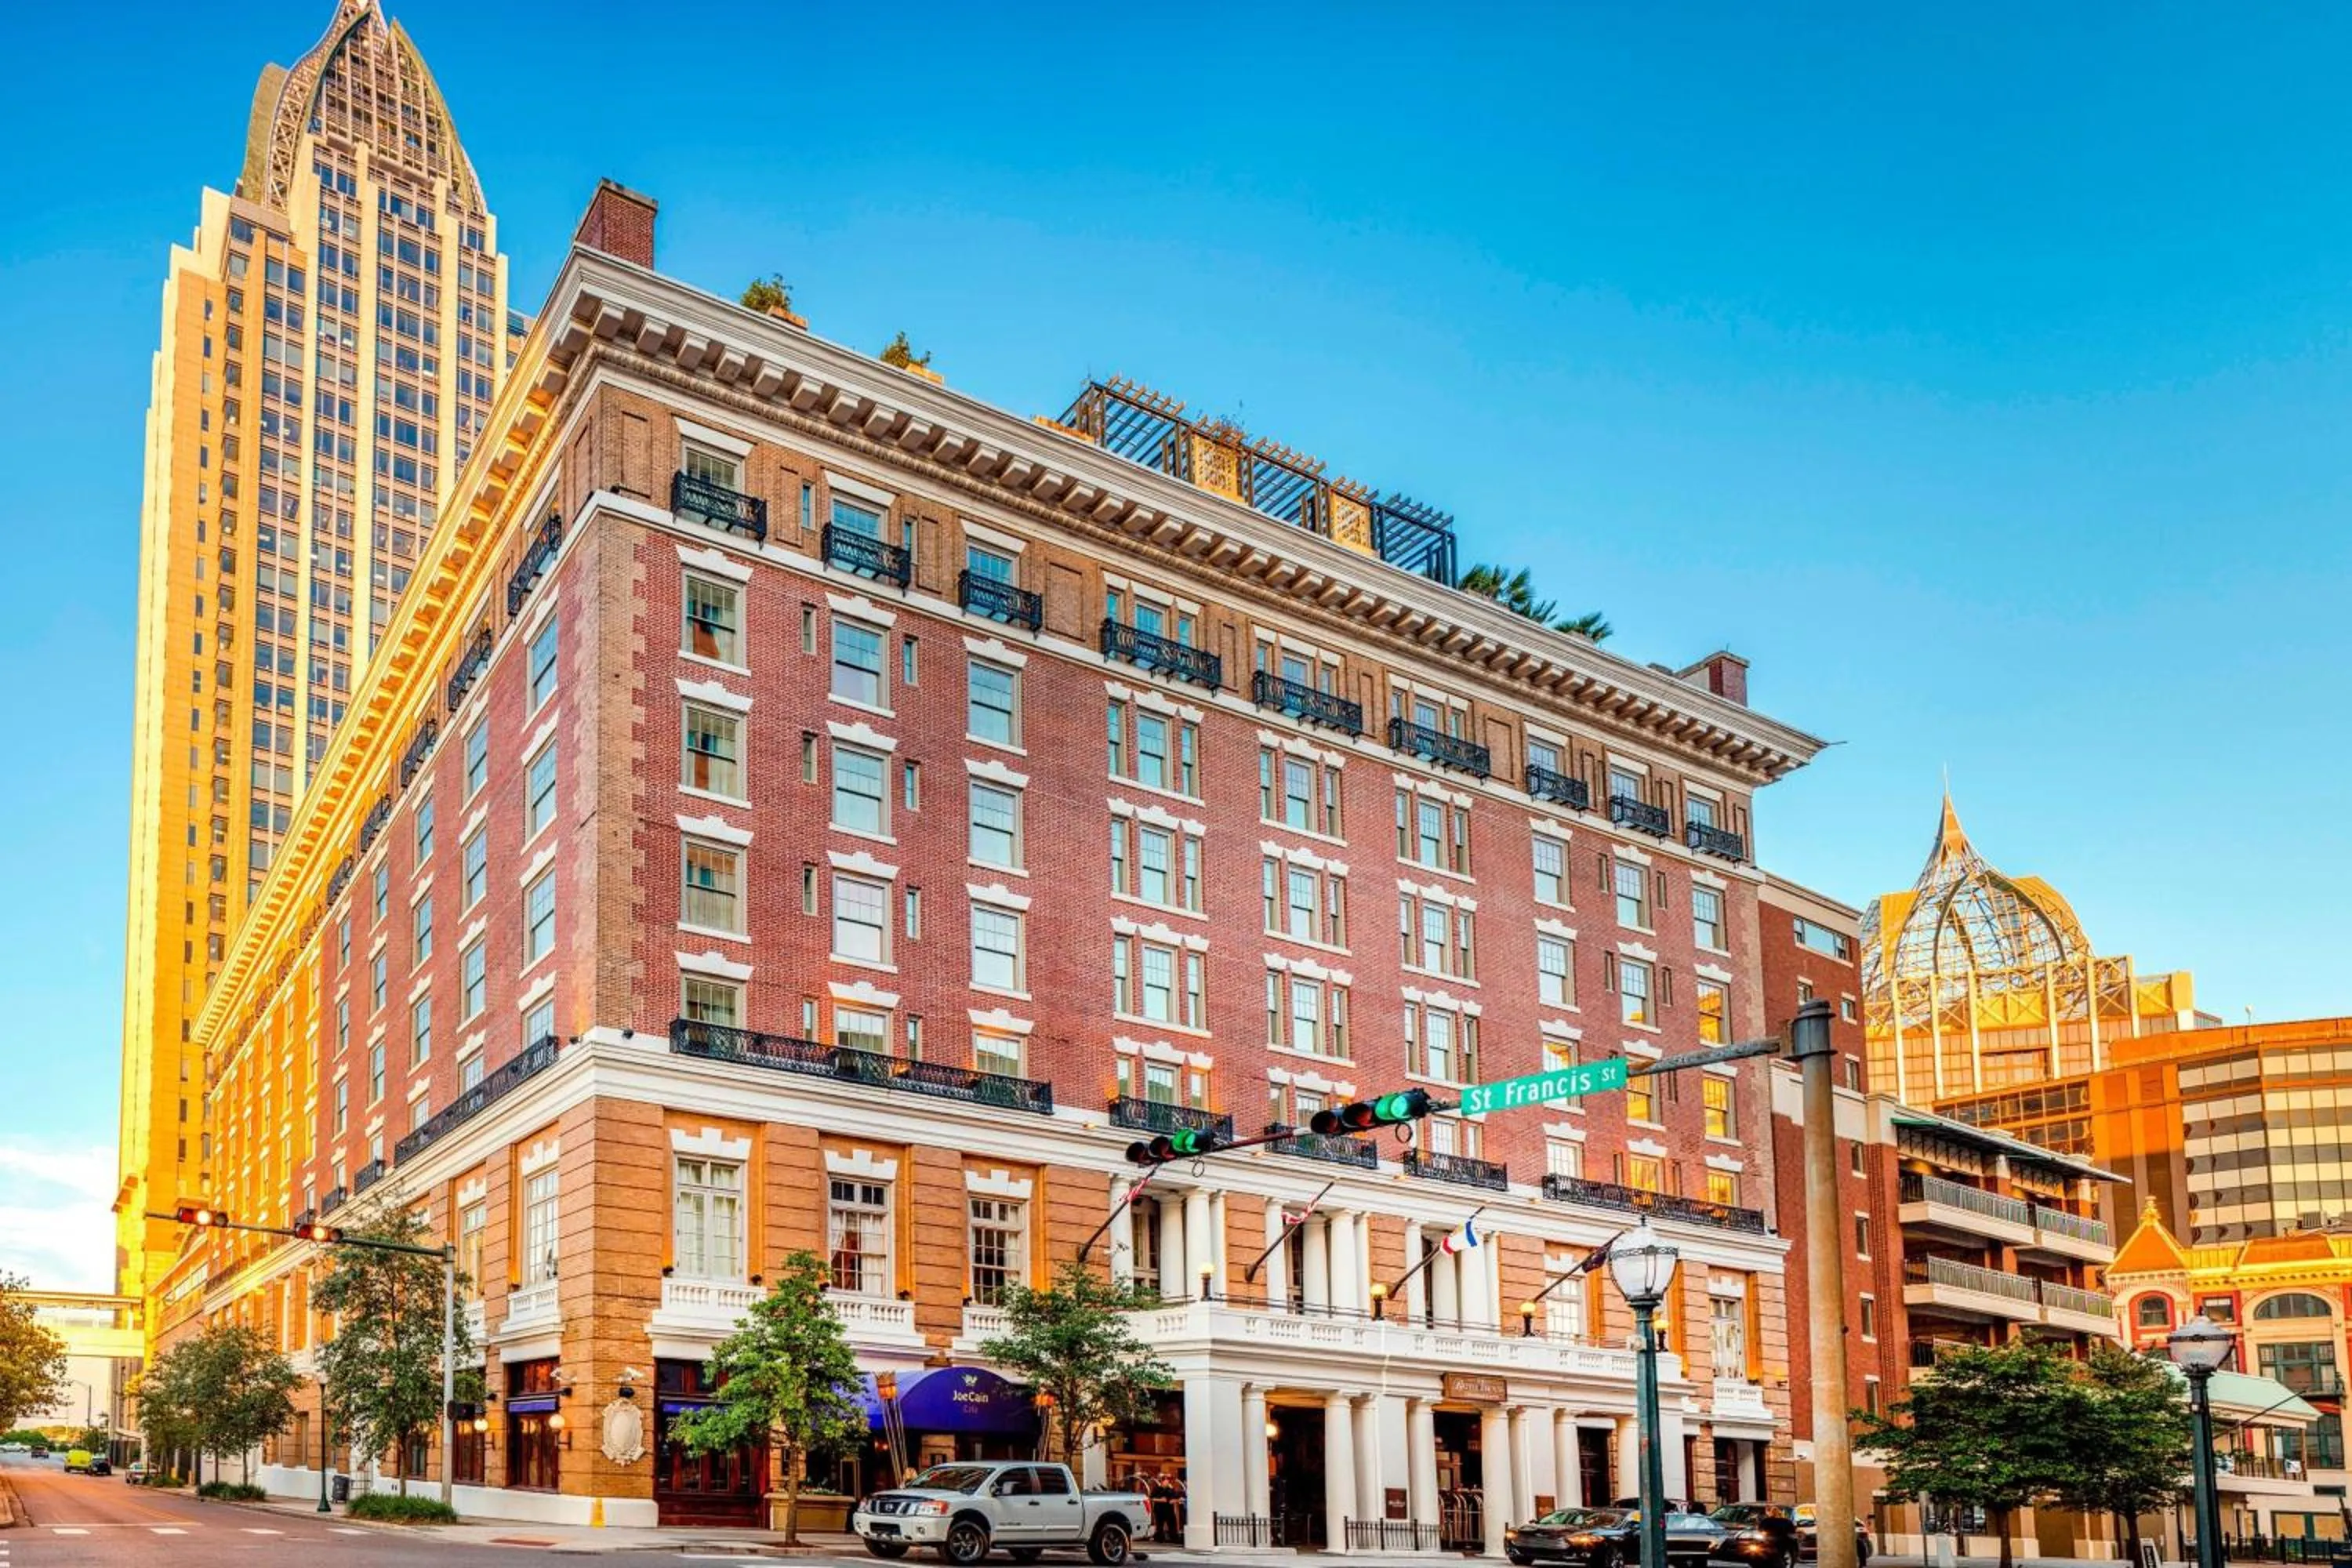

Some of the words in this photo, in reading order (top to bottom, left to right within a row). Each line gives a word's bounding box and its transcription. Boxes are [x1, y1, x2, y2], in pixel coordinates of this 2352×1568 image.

[1470, 1088, 1491, 1111] St
[1505, 1070, 1591, 1105] Francis
[1601, 1066, 1616, 1082] St
